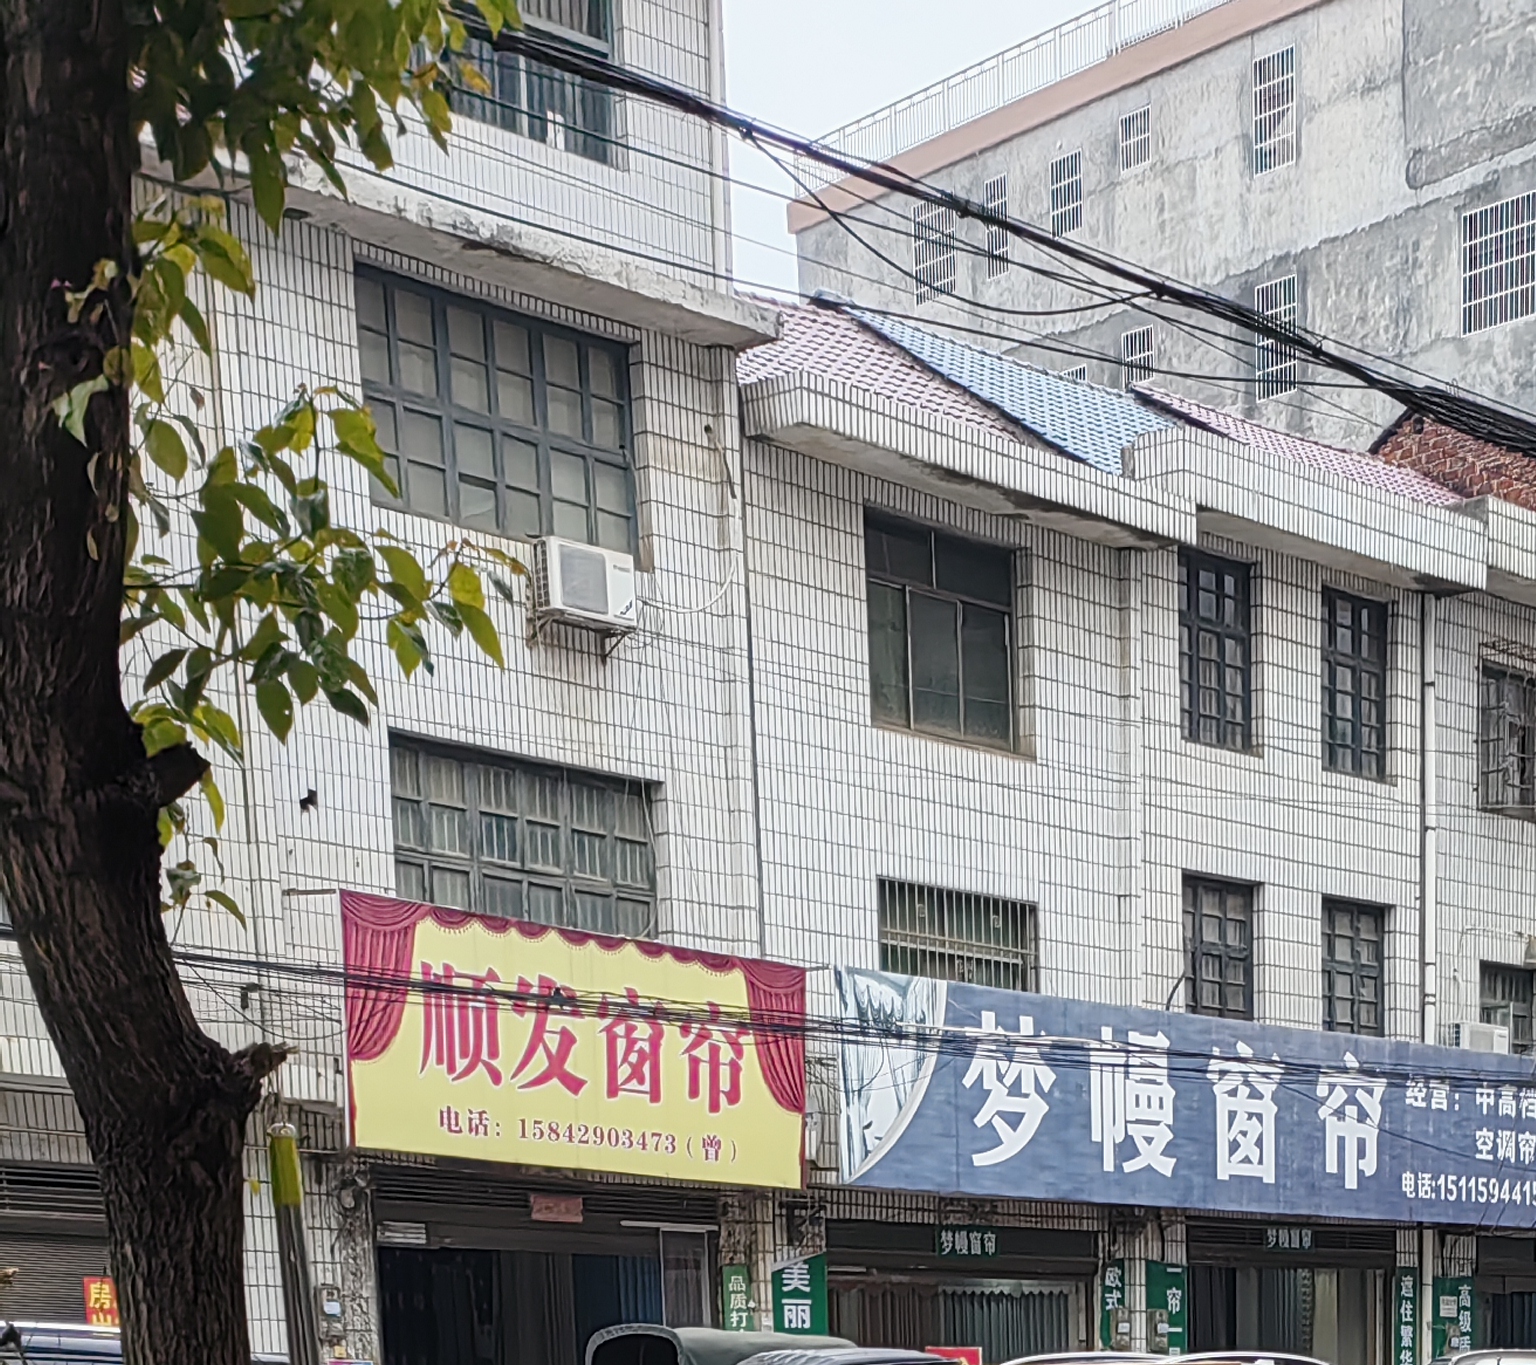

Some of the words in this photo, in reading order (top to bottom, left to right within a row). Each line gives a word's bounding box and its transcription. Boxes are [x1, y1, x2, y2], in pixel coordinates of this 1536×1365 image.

[419, 960, 751, 1115] 顺发窗帘
[961, 1011, 1387, 1190] 梦幔窗帘
[728, 1275, 748, 1333] 品质打
[781, 1261, 812, 1329] 美丽
